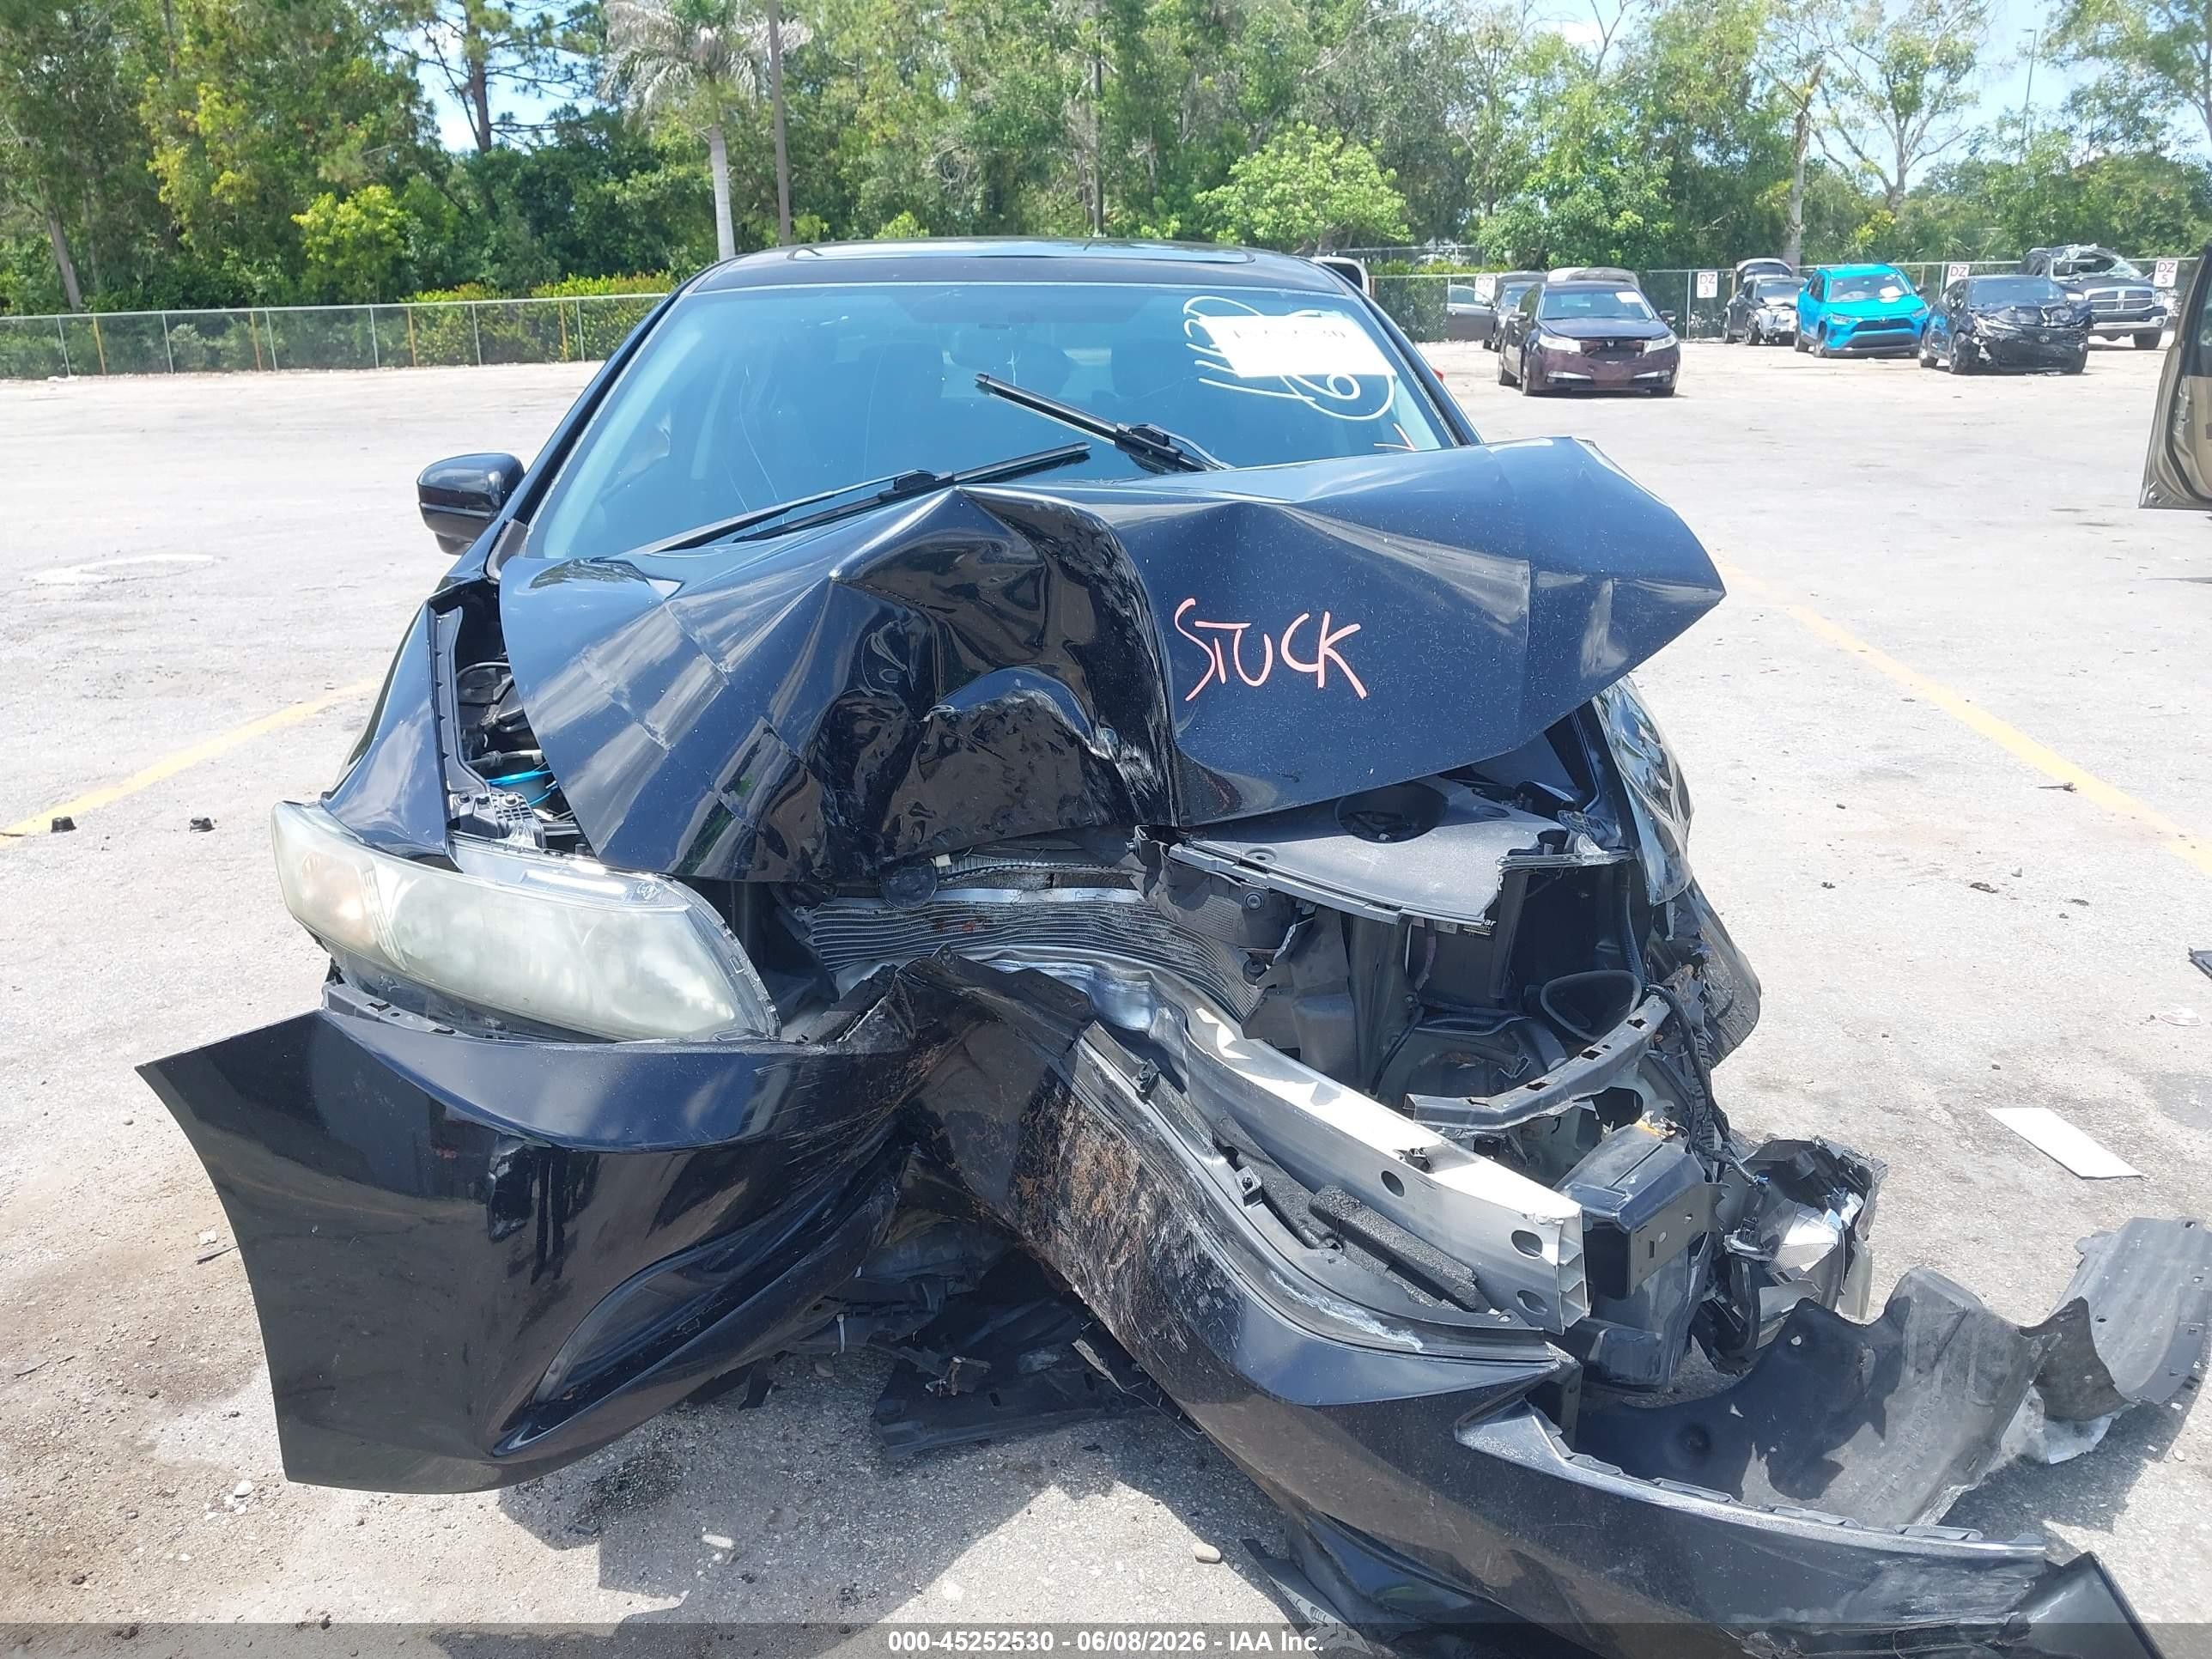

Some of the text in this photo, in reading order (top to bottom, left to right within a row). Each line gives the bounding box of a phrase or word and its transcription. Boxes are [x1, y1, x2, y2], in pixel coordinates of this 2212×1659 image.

[1950, 266, 1967, 277] DZ
[2157, 262, 2176, 273] DZ
[1699, 274, 1716, 284] DZ
[2160, 274, 2168, 284] 5
[1703, 285, 1710, 295] 3
[1174, 598, 1368, 702] STUCK
